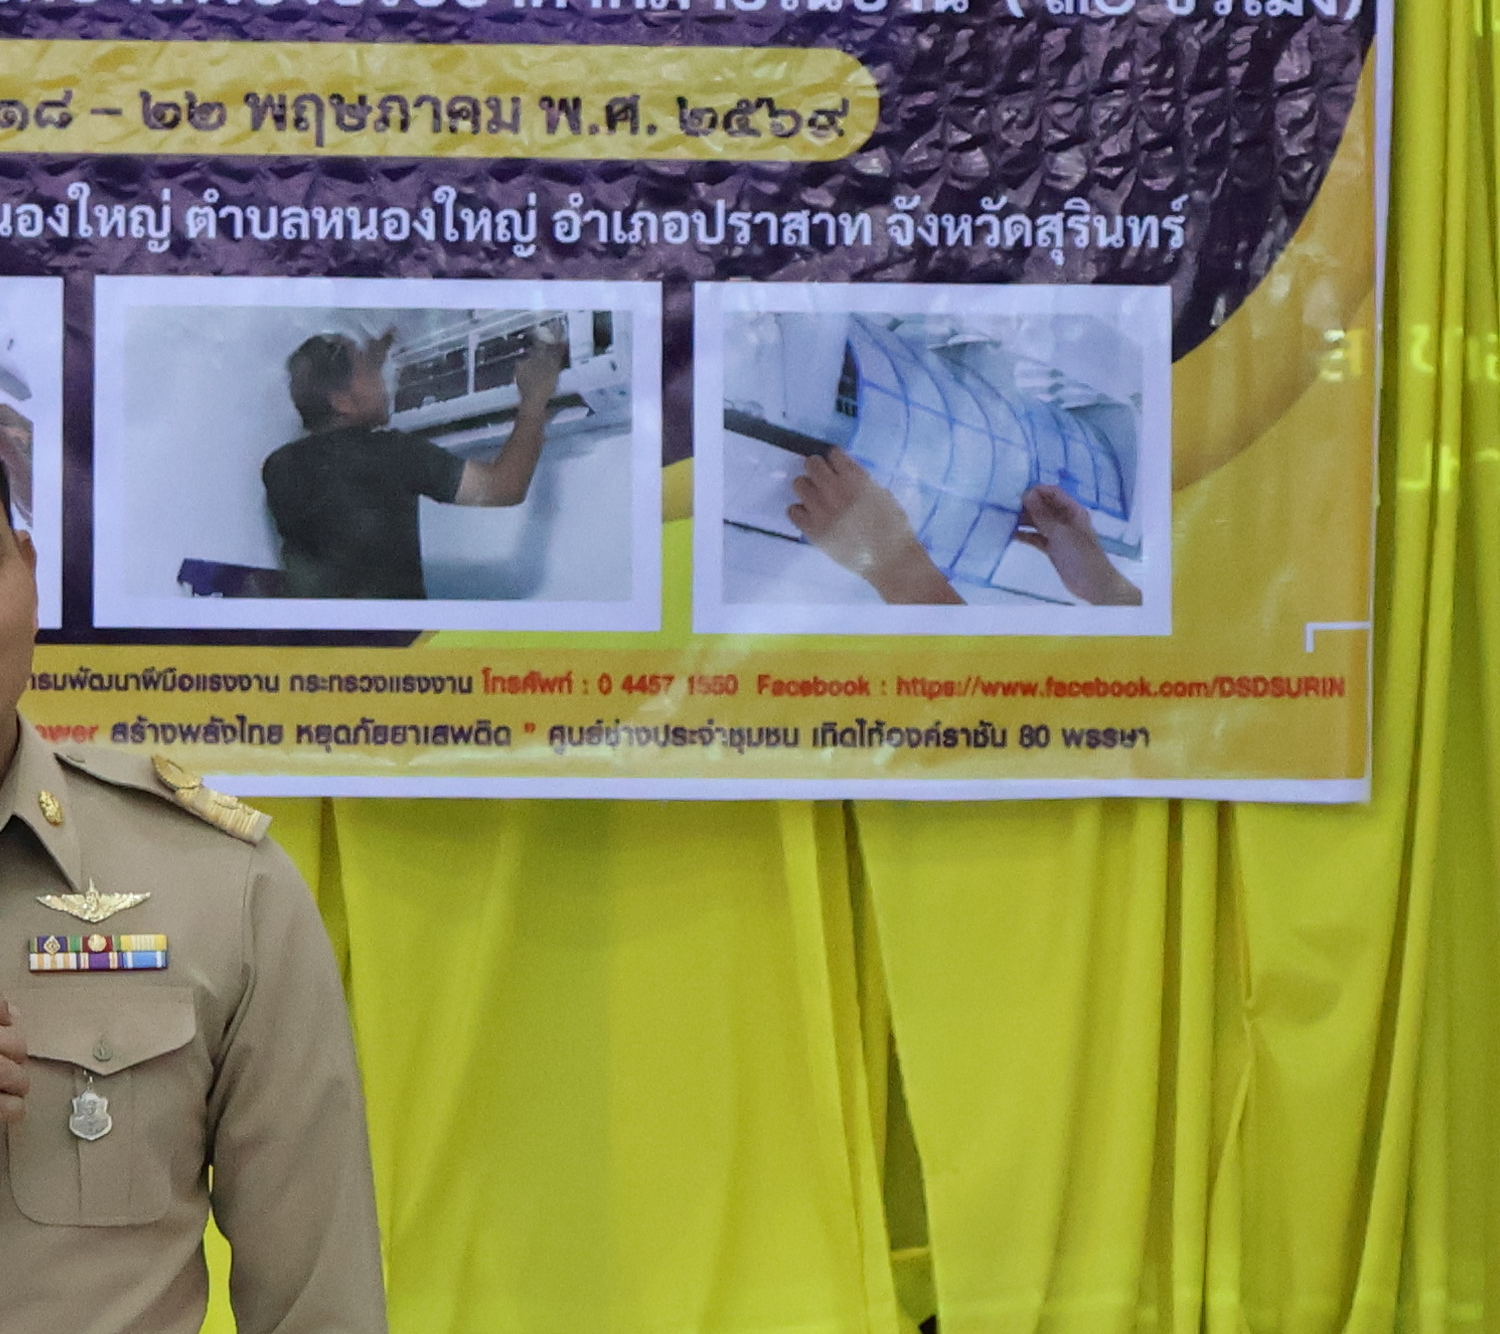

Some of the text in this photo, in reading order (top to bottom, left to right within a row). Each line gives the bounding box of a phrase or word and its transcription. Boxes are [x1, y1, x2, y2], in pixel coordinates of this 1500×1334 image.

[138, 91, 227, 132] ๒๒
[242, 91, 521, 148] พฤษภาคม
[538, 93, 658, 136] พ.ศ.
[674, 95, 850, 140] ๒๕๖๙
[184, 184, 537, 258] ตำบลหนองใหญ่
[552, 188, 874, 250] อำเภอปราสาท
[886, 187, 1188, 268] จังหวัดสุรินทร์
[289, 673, 474, 695] กระทรวงแรงงาน
[480, 666, 574, 695] โทรศัพท์
[756, 673, 872, 698] Facebook
[34, 724, 100, 743] wer
[110, 713, 284, 746] สร้างพลังไทย
[295, 716, 512, 753] หยุดภัยยาเสพติด
[1018, 723, 1051, 750] 80
[1060, 726, 1151, 750] พรรษา
